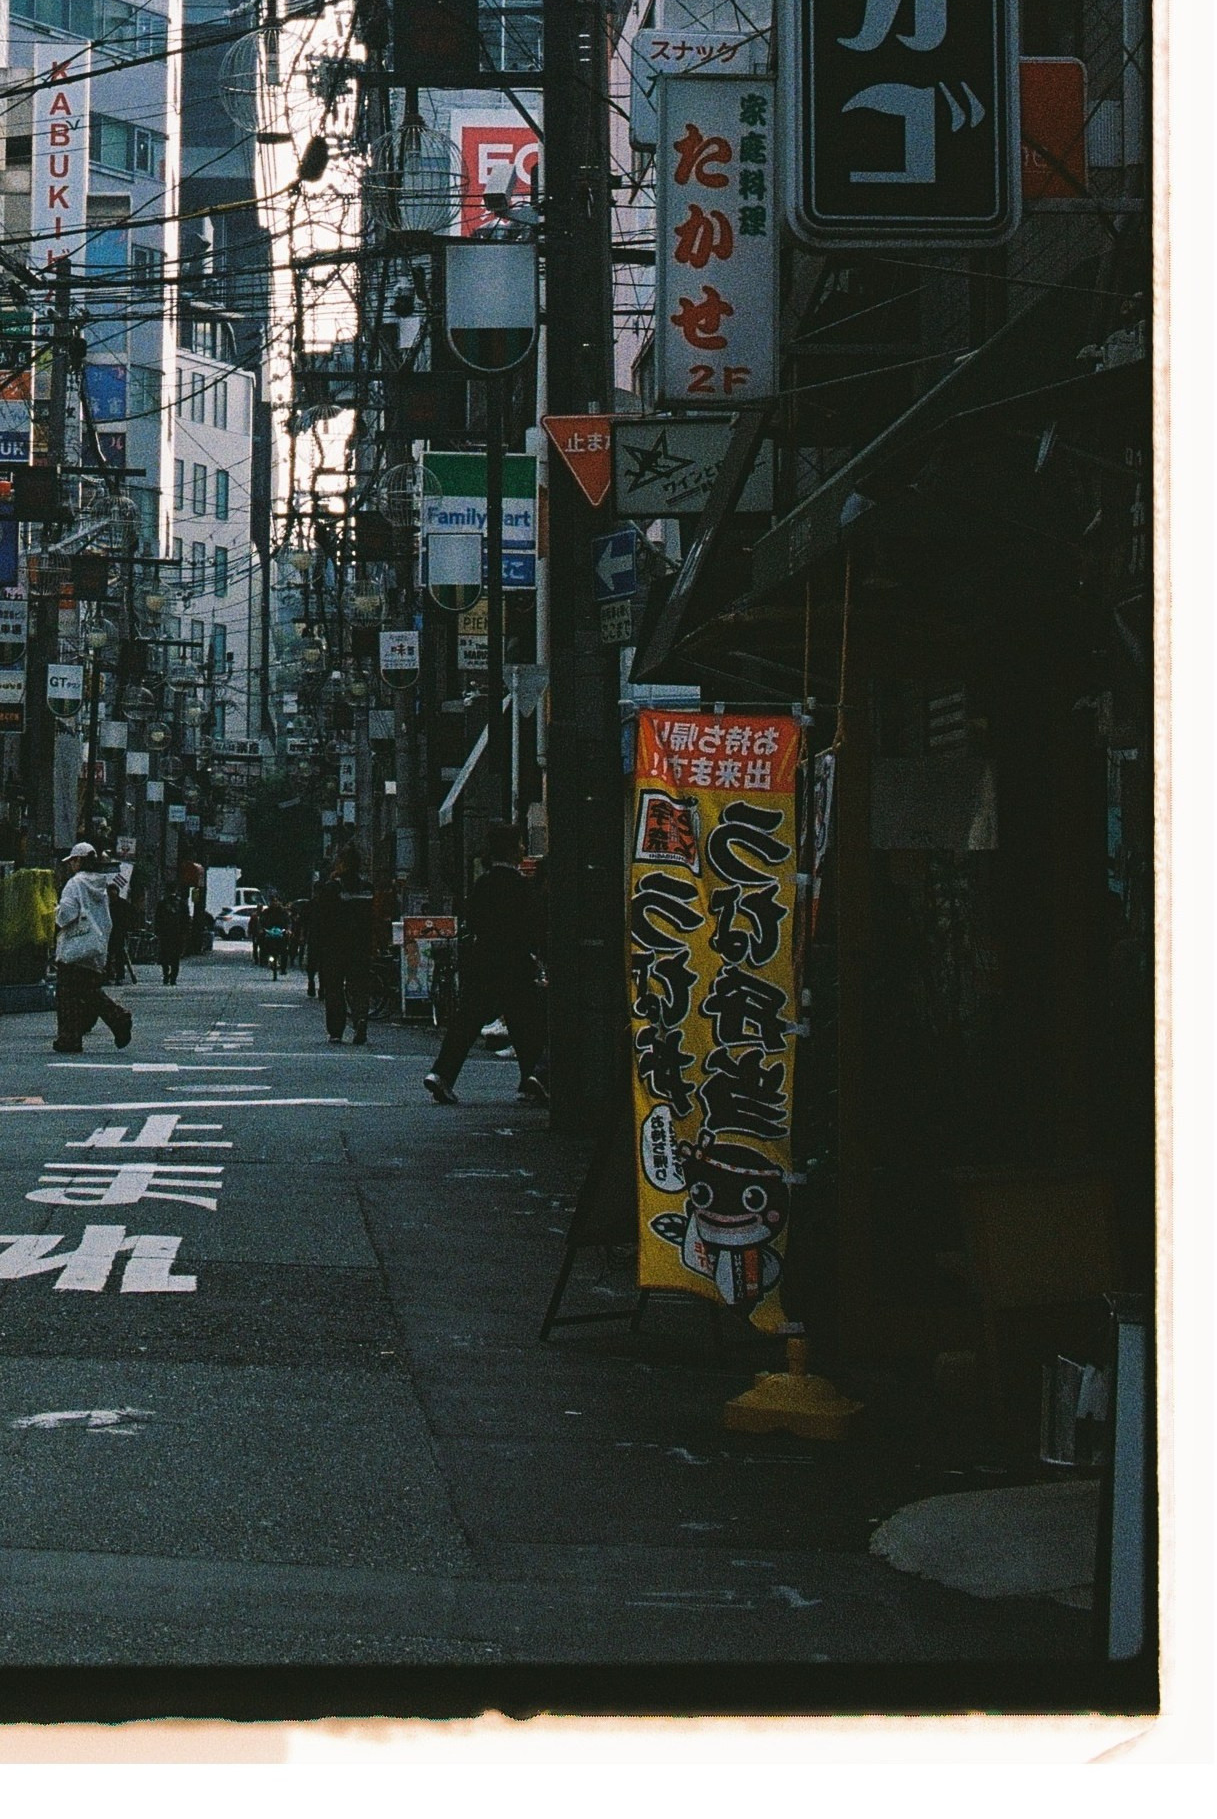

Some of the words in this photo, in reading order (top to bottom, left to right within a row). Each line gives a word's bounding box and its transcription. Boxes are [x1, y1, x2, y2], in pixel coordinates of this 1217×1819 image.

[650, 40, 739, 63] スナック
[740, 92, 768, 237] 家庭料理
[672, 123, 734, 350] たかせ
[688, 364, 751, 395] 2F
[428, 507, 531, 530] Familyart
